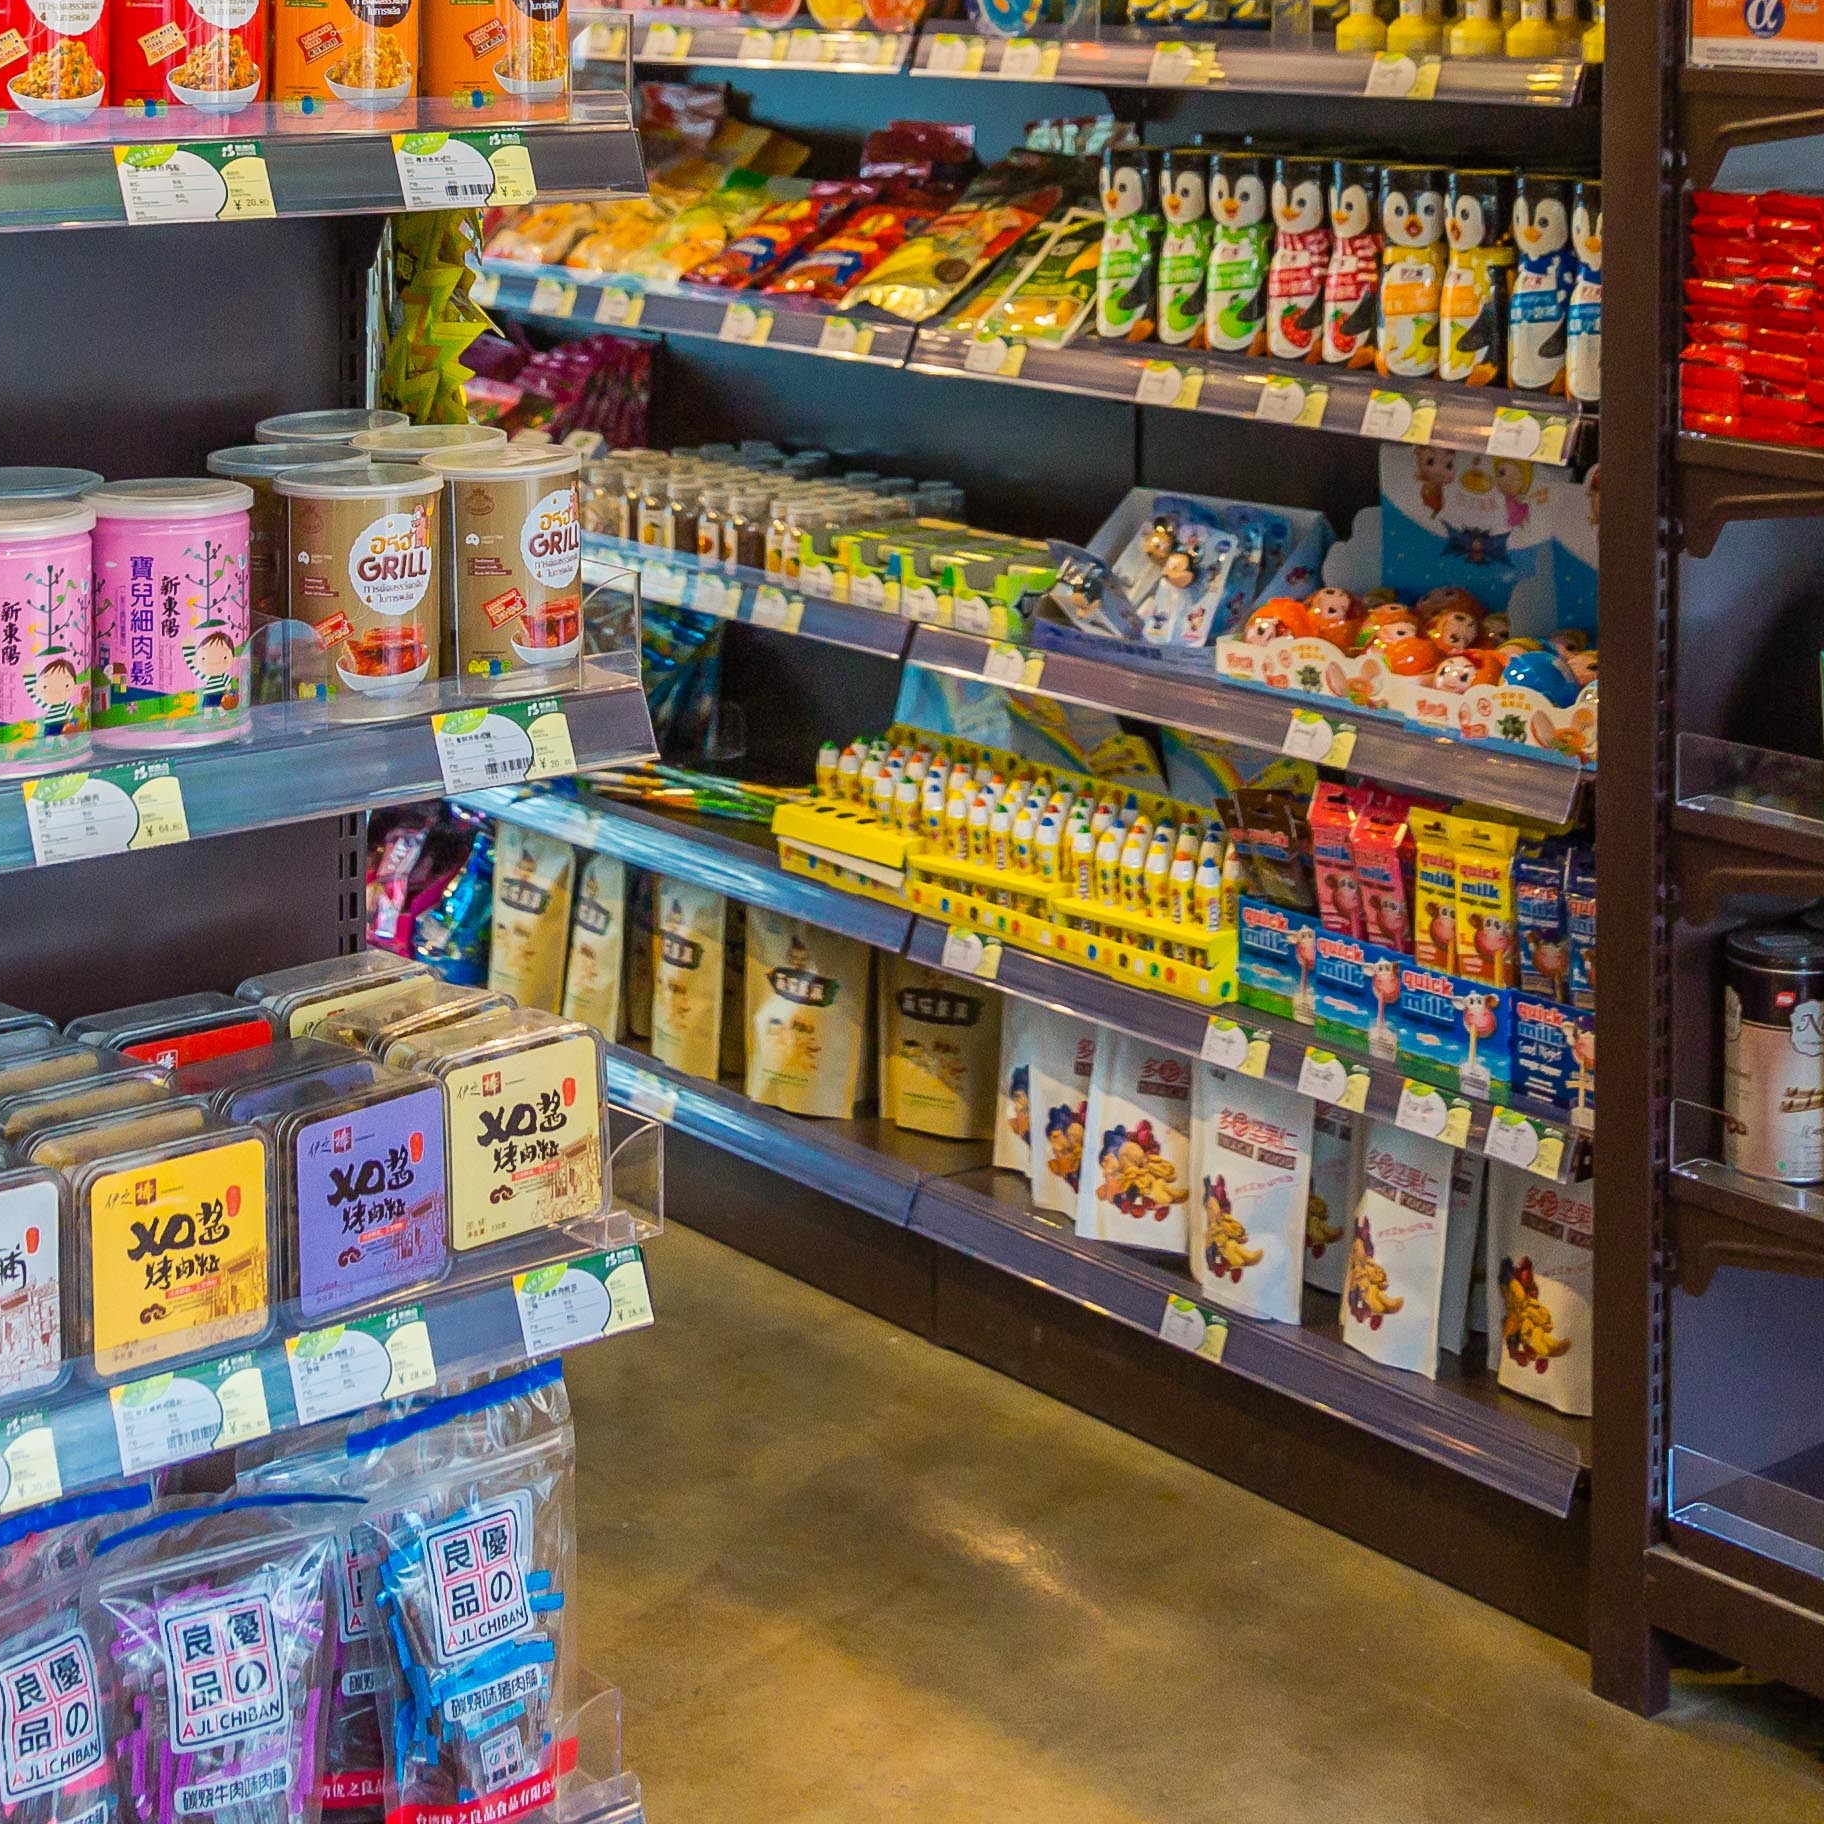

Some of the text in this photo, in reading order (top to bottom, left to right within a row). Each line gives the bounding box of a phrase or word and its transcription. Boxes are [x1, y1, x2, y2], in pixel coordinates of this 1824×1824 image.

[528, 525, 579, 558] GRILL
[357, 550, 427, 583] GRILL
[160, 575, 180, 639] 新東陽
[1, 601, 22, 667] 新東陽
